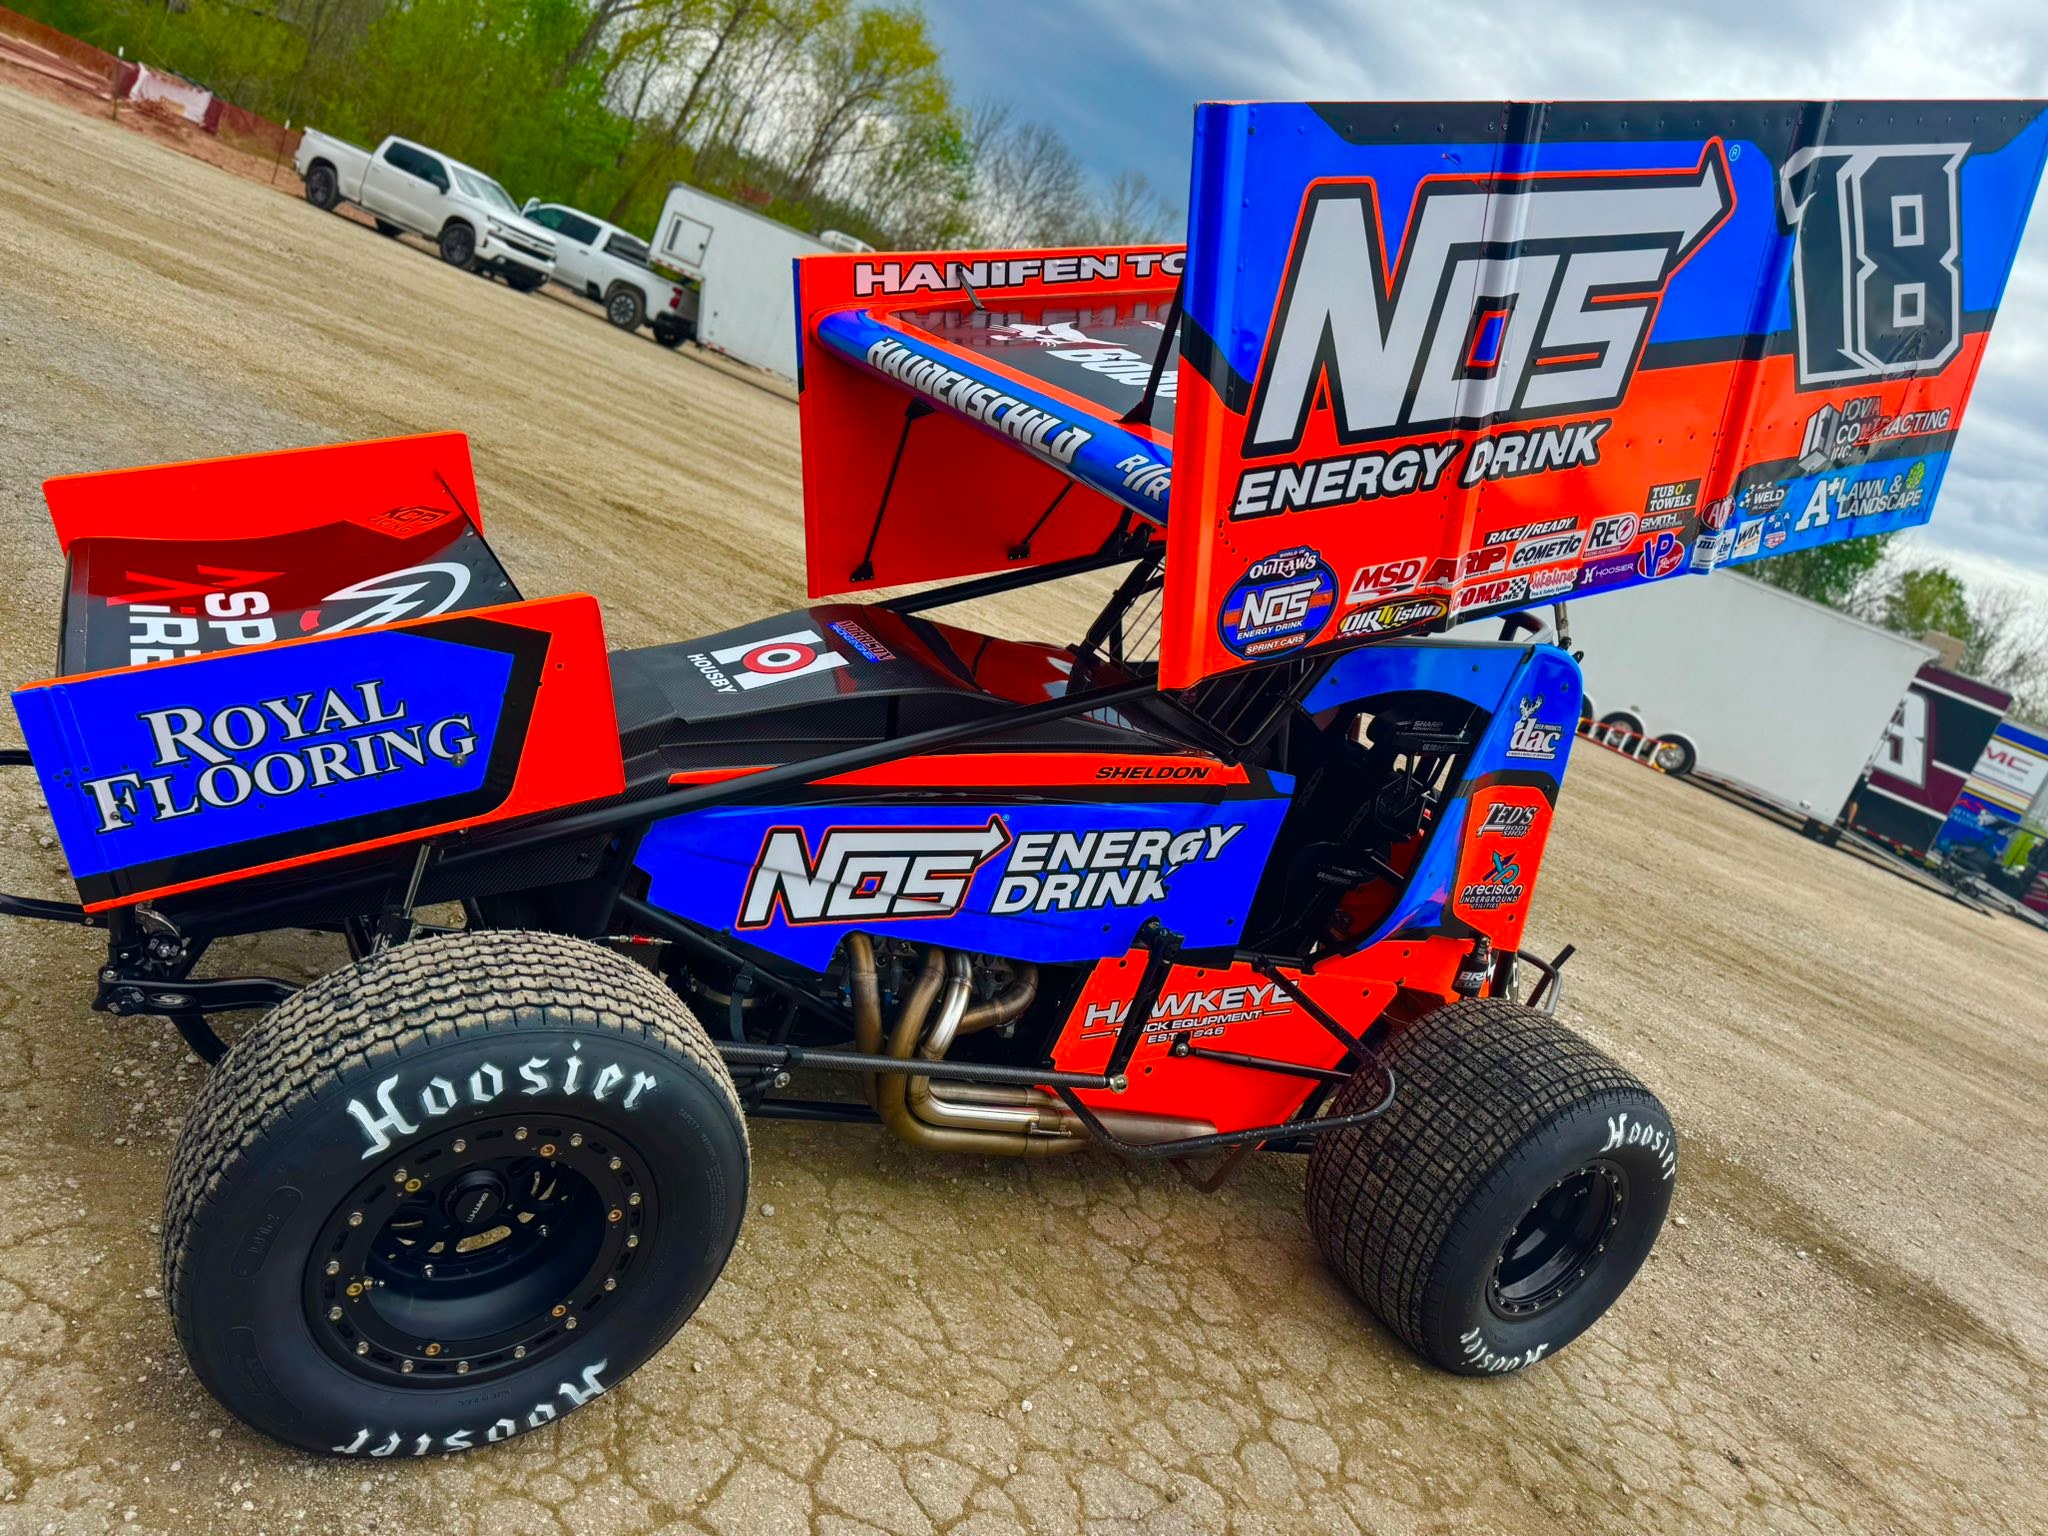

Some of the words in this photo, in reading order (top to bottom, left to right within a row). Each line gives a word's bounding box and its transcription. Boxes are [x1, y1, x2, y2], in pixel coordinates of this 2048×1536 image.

[856, 256, 1118, 295] HANIFEN
[1779, 142, 1972, 384] 18
[1251, 168, 1724, 446] NOS
[867, 338, 1092, 464] HAUDENSCHILD
[1234, 446, 1455, 517] ENERGY
[1467, 421, 1611, 483] DRINK
[1837, 478, 1885, 504] LAWN
[1889, 474, 1902, 494] &
[1650, 493, 1693, 511] TOWELS
[1653, 486, 1674, 498] TUB
[1754, 489, 1784, 504] WELD
[1837, 489, 1924, 520] LANDSCAPE
[1640, 513, 1678, 529] SMITH
[1512, 535, 1582, 564] COMETIC
[1644, 532, 1675, 577] VP
[1352, 560, 1421, 592] MSD
[1452, 581, 1511, 611] COMP
[1240, 577, 1323, 630] NOS
[1237, 626, 1275, 640] ENERGY
[1275, 619, 1304, 632] DRINK
[1246, 641, 1279, 654] SPRINT
[1280, 634, 1305, 646] CARS
[687, 653, 738, 694] HOUSBY
[1510, 718, 1561, 752] dac
[86, 714, 478, 834] FLOORING
[1096, 765, 1210, 780] SHELDON
[1003, 824, 1246, 874] ENERGY
[743, 822, 1008, 923] NOS
[989, 870, 1170, 915] DRINK
[1171, 1010, 1264, 1030] EQUIPMENT
[346, 1038, 657, 1160] Hoosier
[1600, 1112, 1677, 1180] Hoosier
[1459, 1326, 1550, 1373] Hoosier
[332, 1357, 609, 1457] Hoosier
